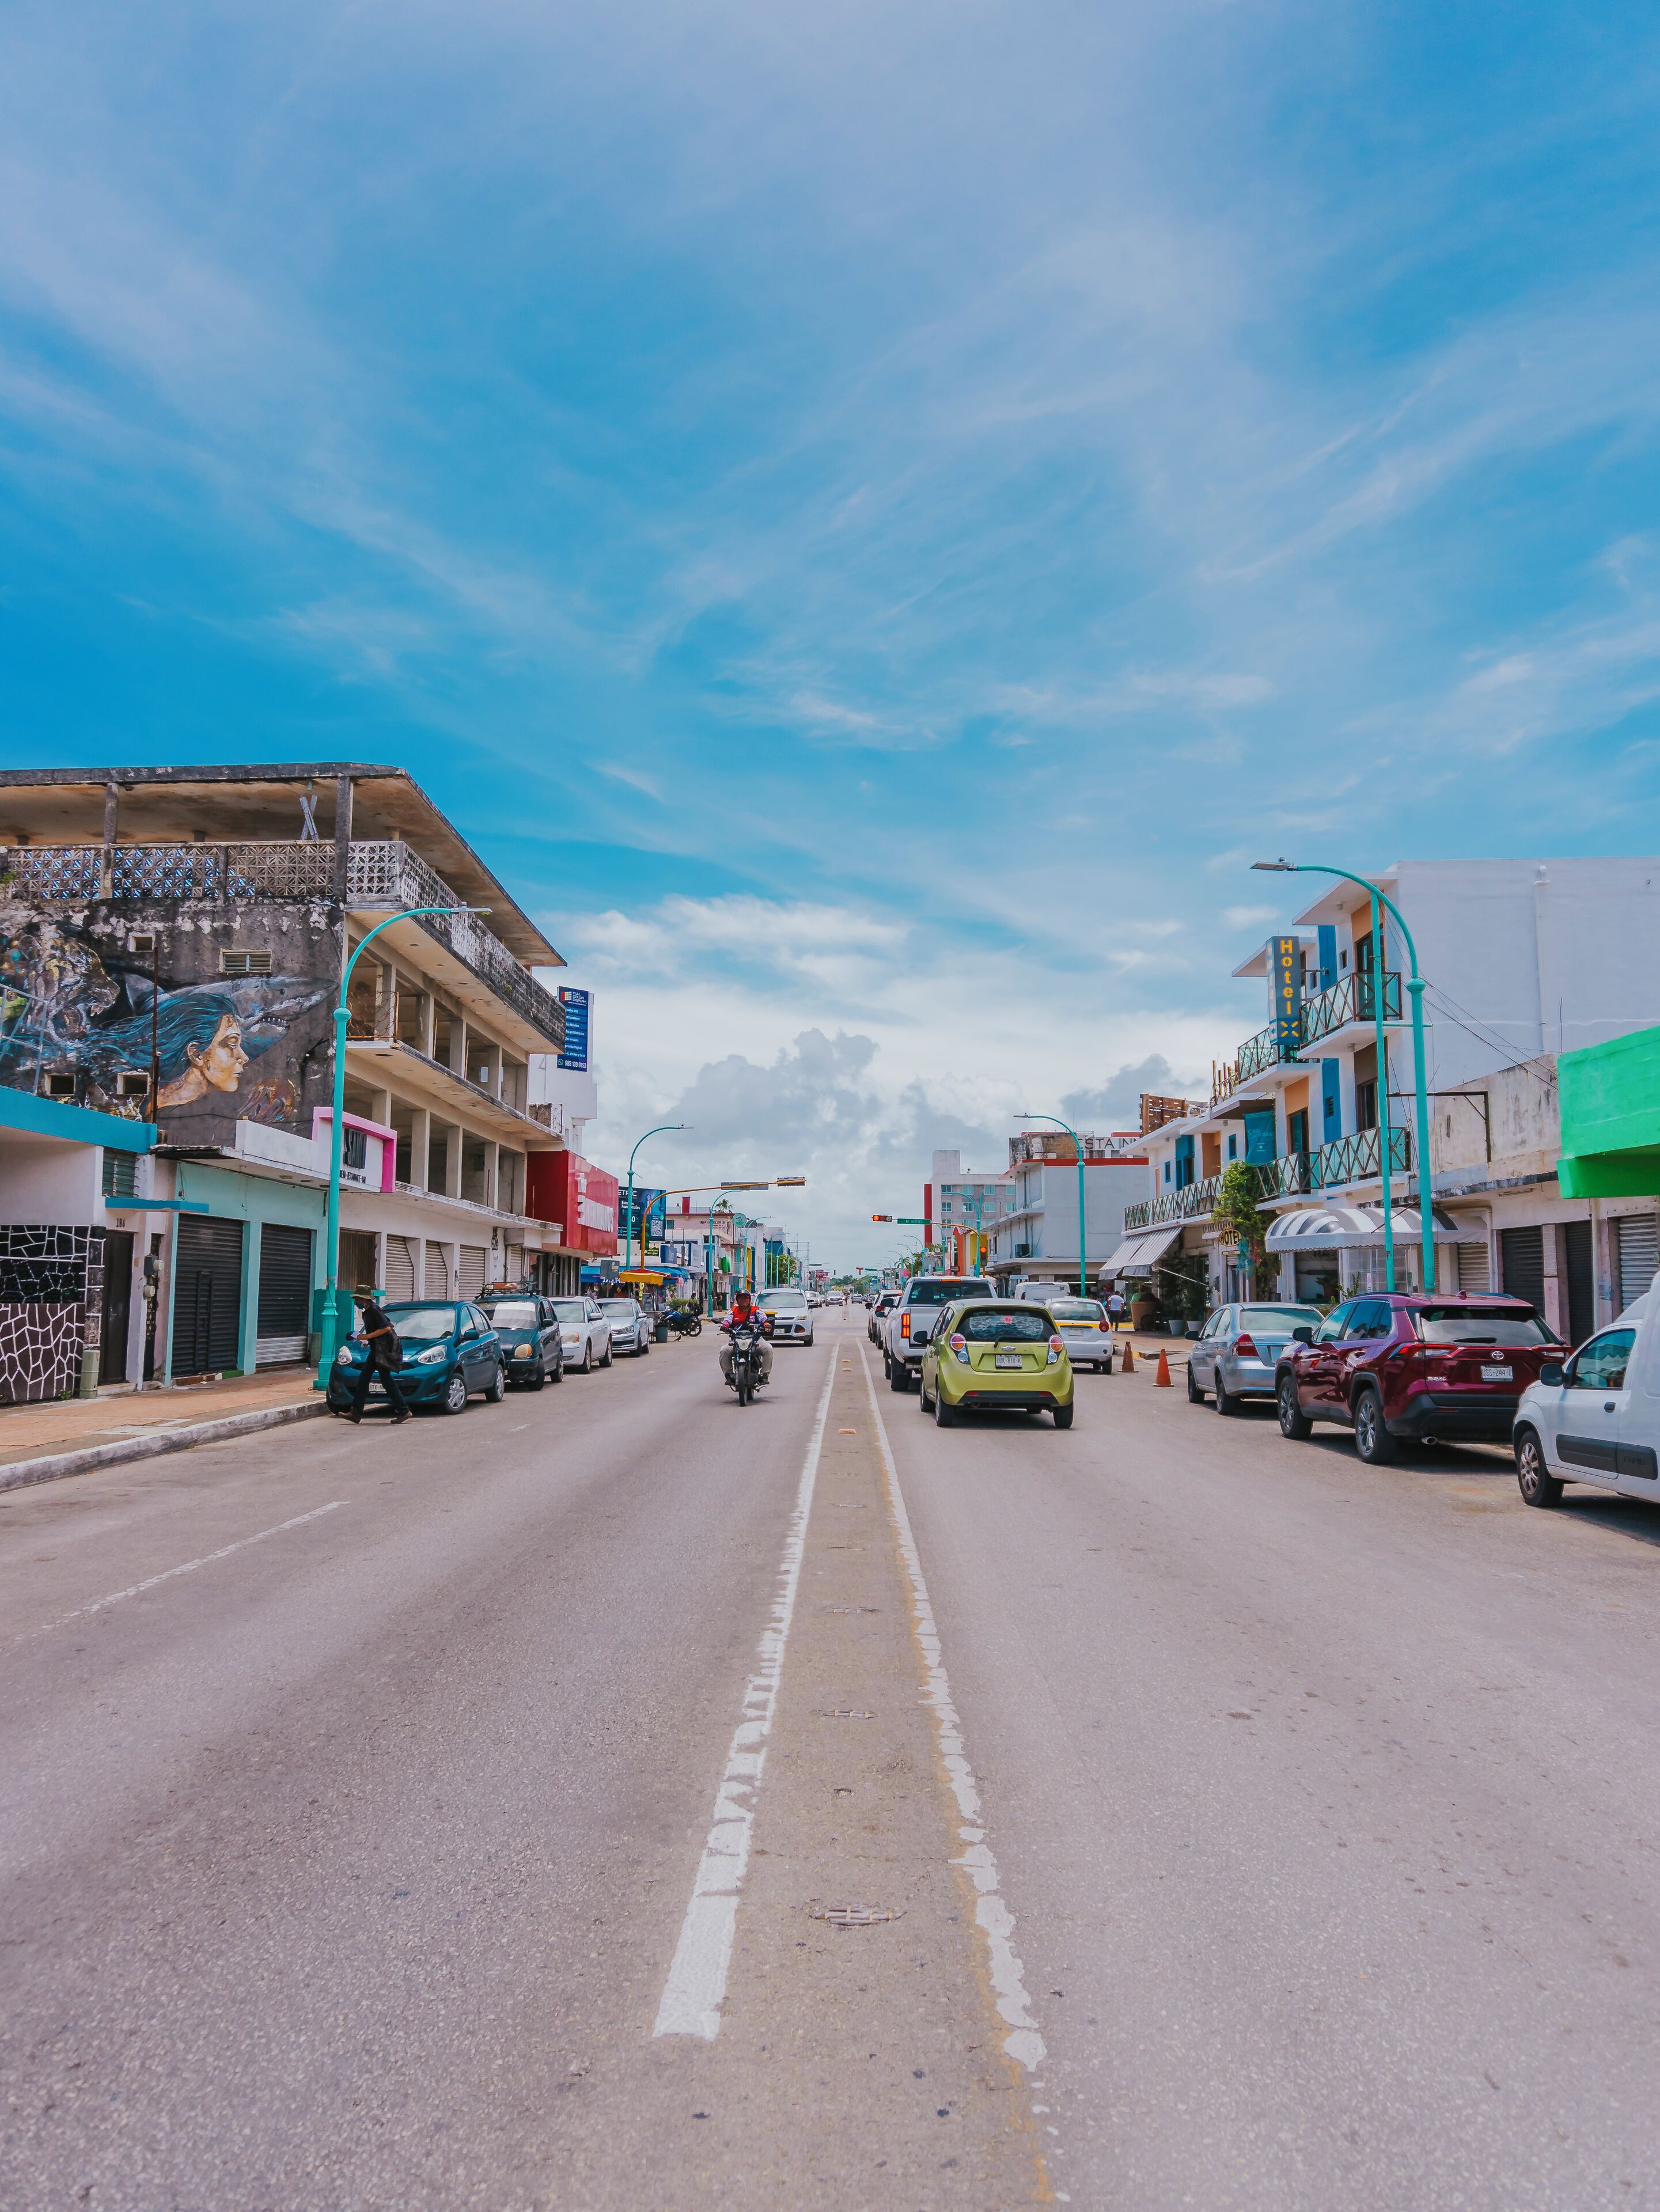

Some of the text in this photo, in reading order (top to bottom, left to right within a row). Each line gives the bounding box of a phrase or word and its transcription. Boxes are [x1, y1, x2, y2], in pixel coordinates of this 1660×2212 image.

[1280, 940, 1294, 1015] Hotel
[1220, 1230, 1241, 1245] HOTEL
[1483, 1369, 1512, 1377] USS-244-L
